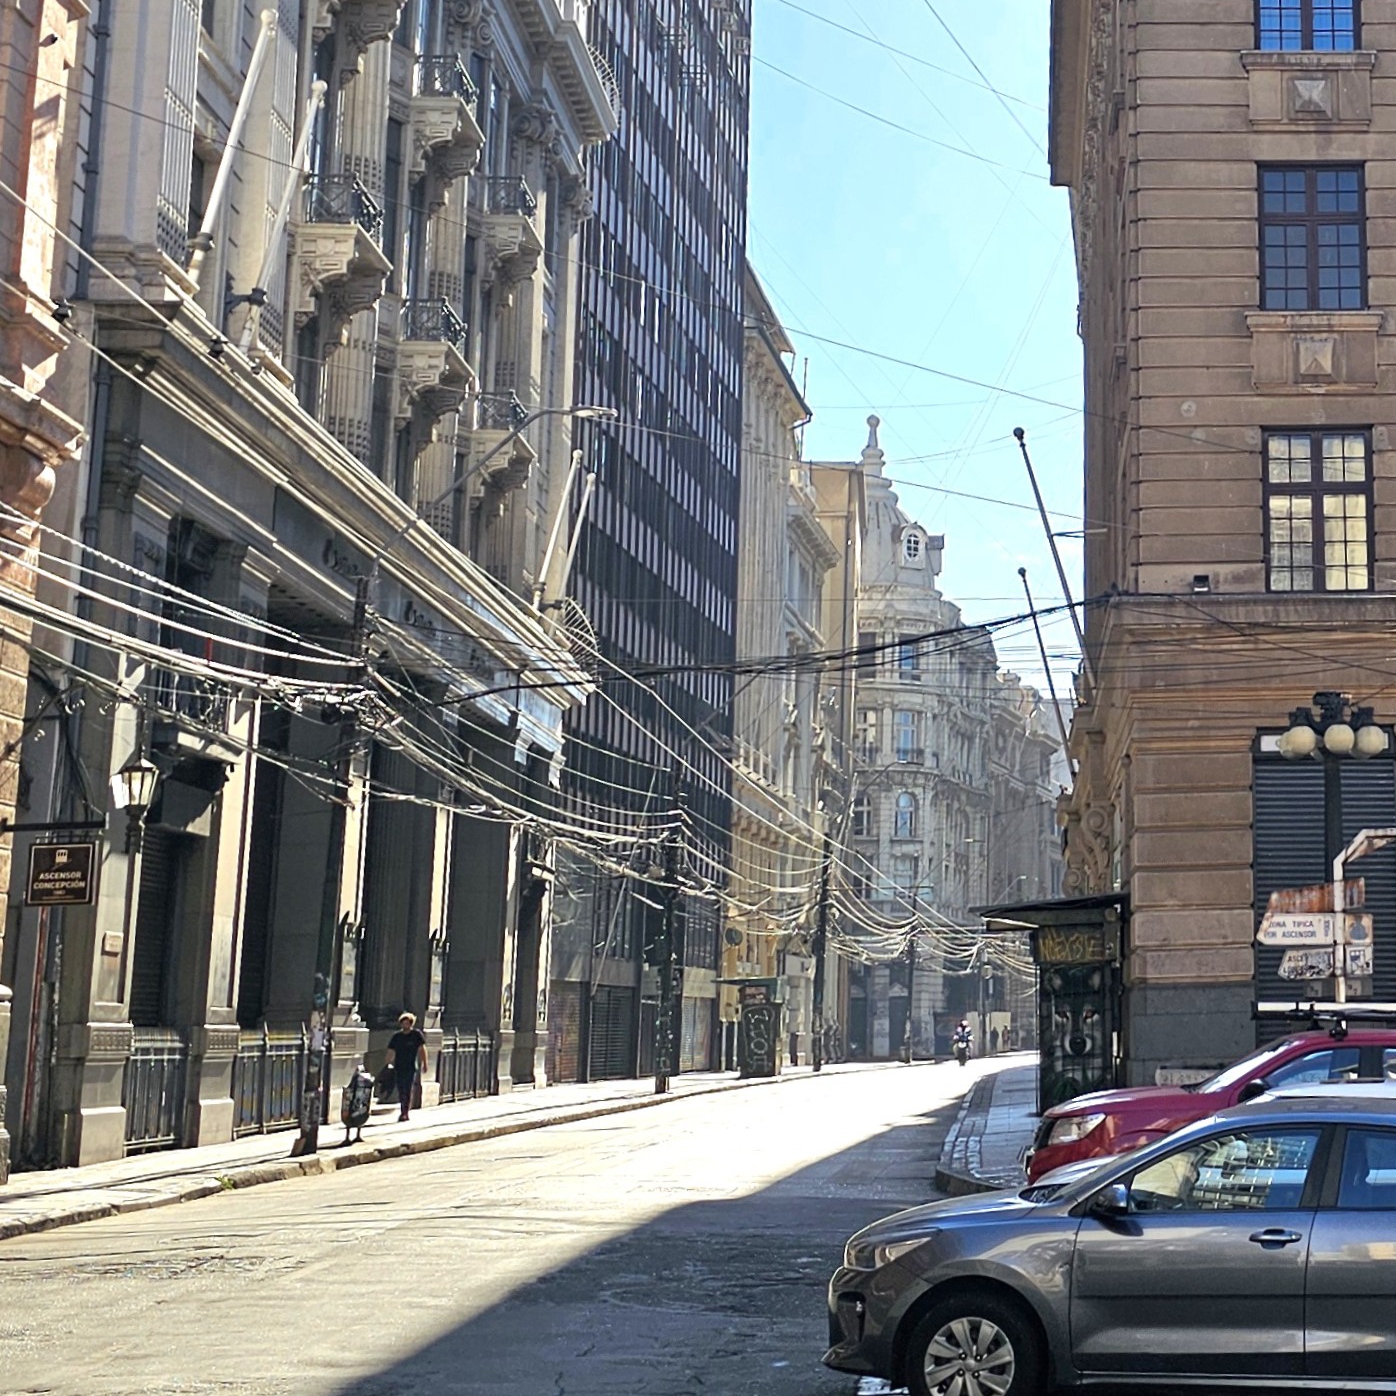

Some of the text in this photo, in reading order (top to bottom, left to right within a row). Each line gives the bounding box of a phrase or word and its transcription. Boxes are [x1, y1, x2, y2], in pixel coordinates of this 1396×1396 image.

[39, 871, 82, 880] ASCENSOR
[33, 880, 86, 889] CONCEPCIÓN
[1282, 931, 1317, 939] ASCENSOR
